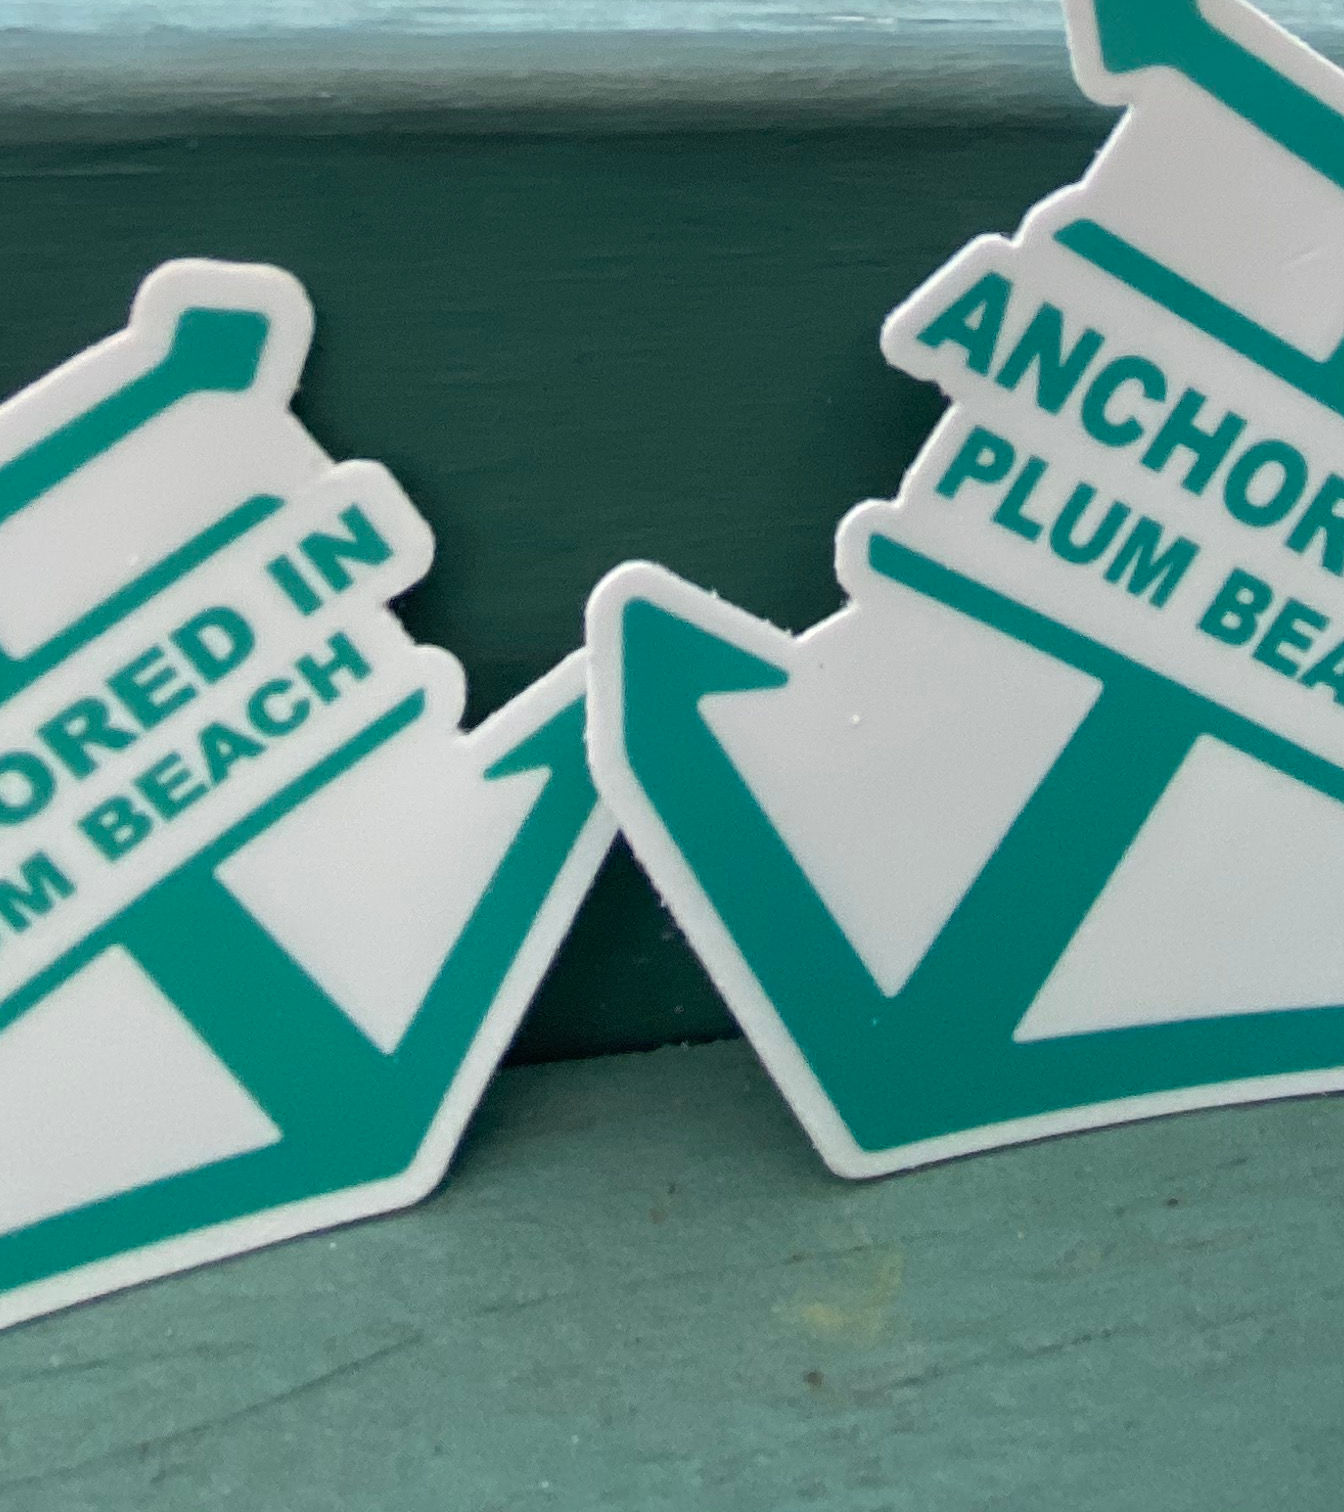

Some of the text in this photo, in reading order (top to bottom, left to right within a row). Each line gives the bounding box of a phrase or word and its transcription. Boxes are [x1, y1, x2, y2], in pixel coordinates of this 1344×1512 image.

[266, 504, 393, 615] IN
[935, 426, 1200, 609] PLUM
[76, 631, 372, 863] BEACH
